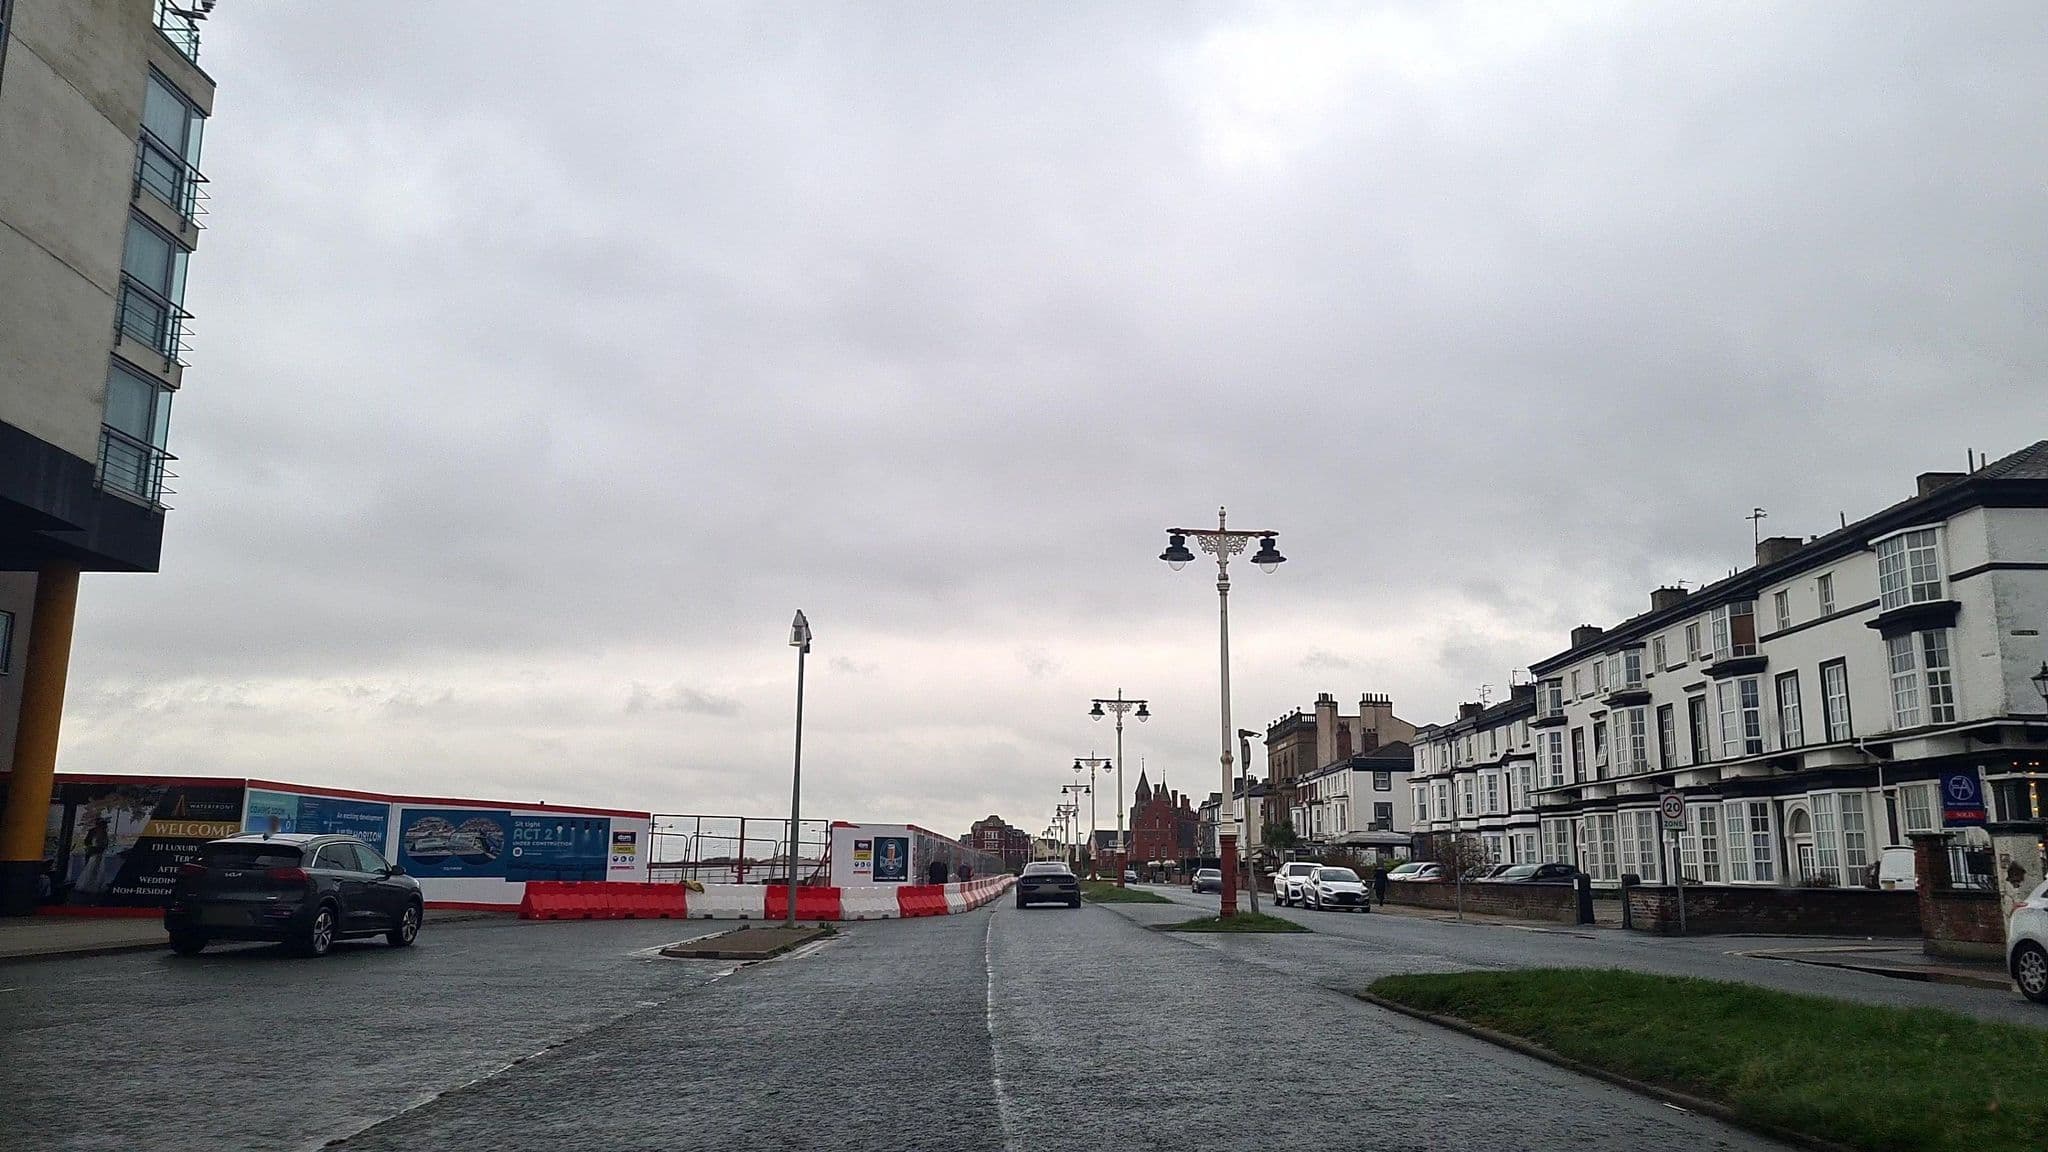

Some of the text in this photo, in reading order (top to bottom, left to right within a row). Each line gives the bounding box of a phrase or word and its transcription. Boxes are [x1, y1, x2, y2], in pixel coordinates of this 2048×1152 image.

[1666, 802, 1680, 812] 20
[154, 823, 235, 837] WELCOME
[513, 828, 553, 840] ACT 2
[165, 843, 198, 853] LUXURY
